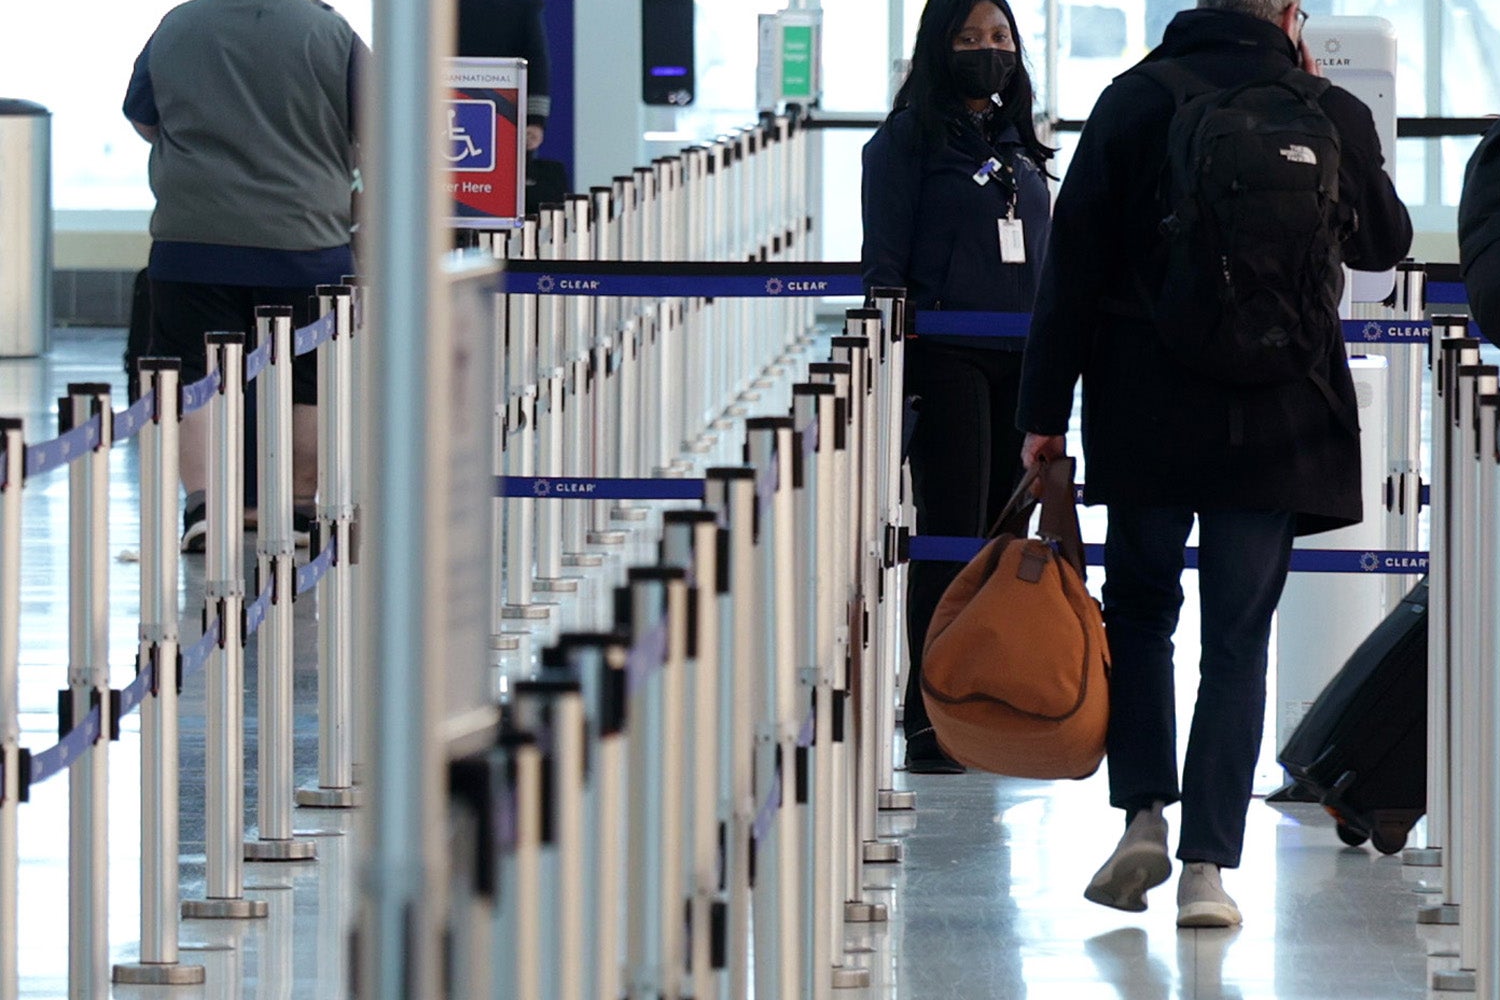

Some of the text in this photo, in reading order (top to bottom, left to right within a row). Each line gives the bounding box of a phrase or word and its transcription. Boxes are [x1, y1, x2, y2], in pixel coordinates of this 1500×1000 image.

[1315, 58, 1351, 67] CLEAR
[462, 180, 492, 194] Here
[560, 280, 598, 290] CLEAR
[788, 281, 826, 291] CLEAR
[1388, 327, 1430, 337] CLEAR
[556, 483, 594, 493] CLEAR
[1385, 557, 1426, 567] CLEAR
